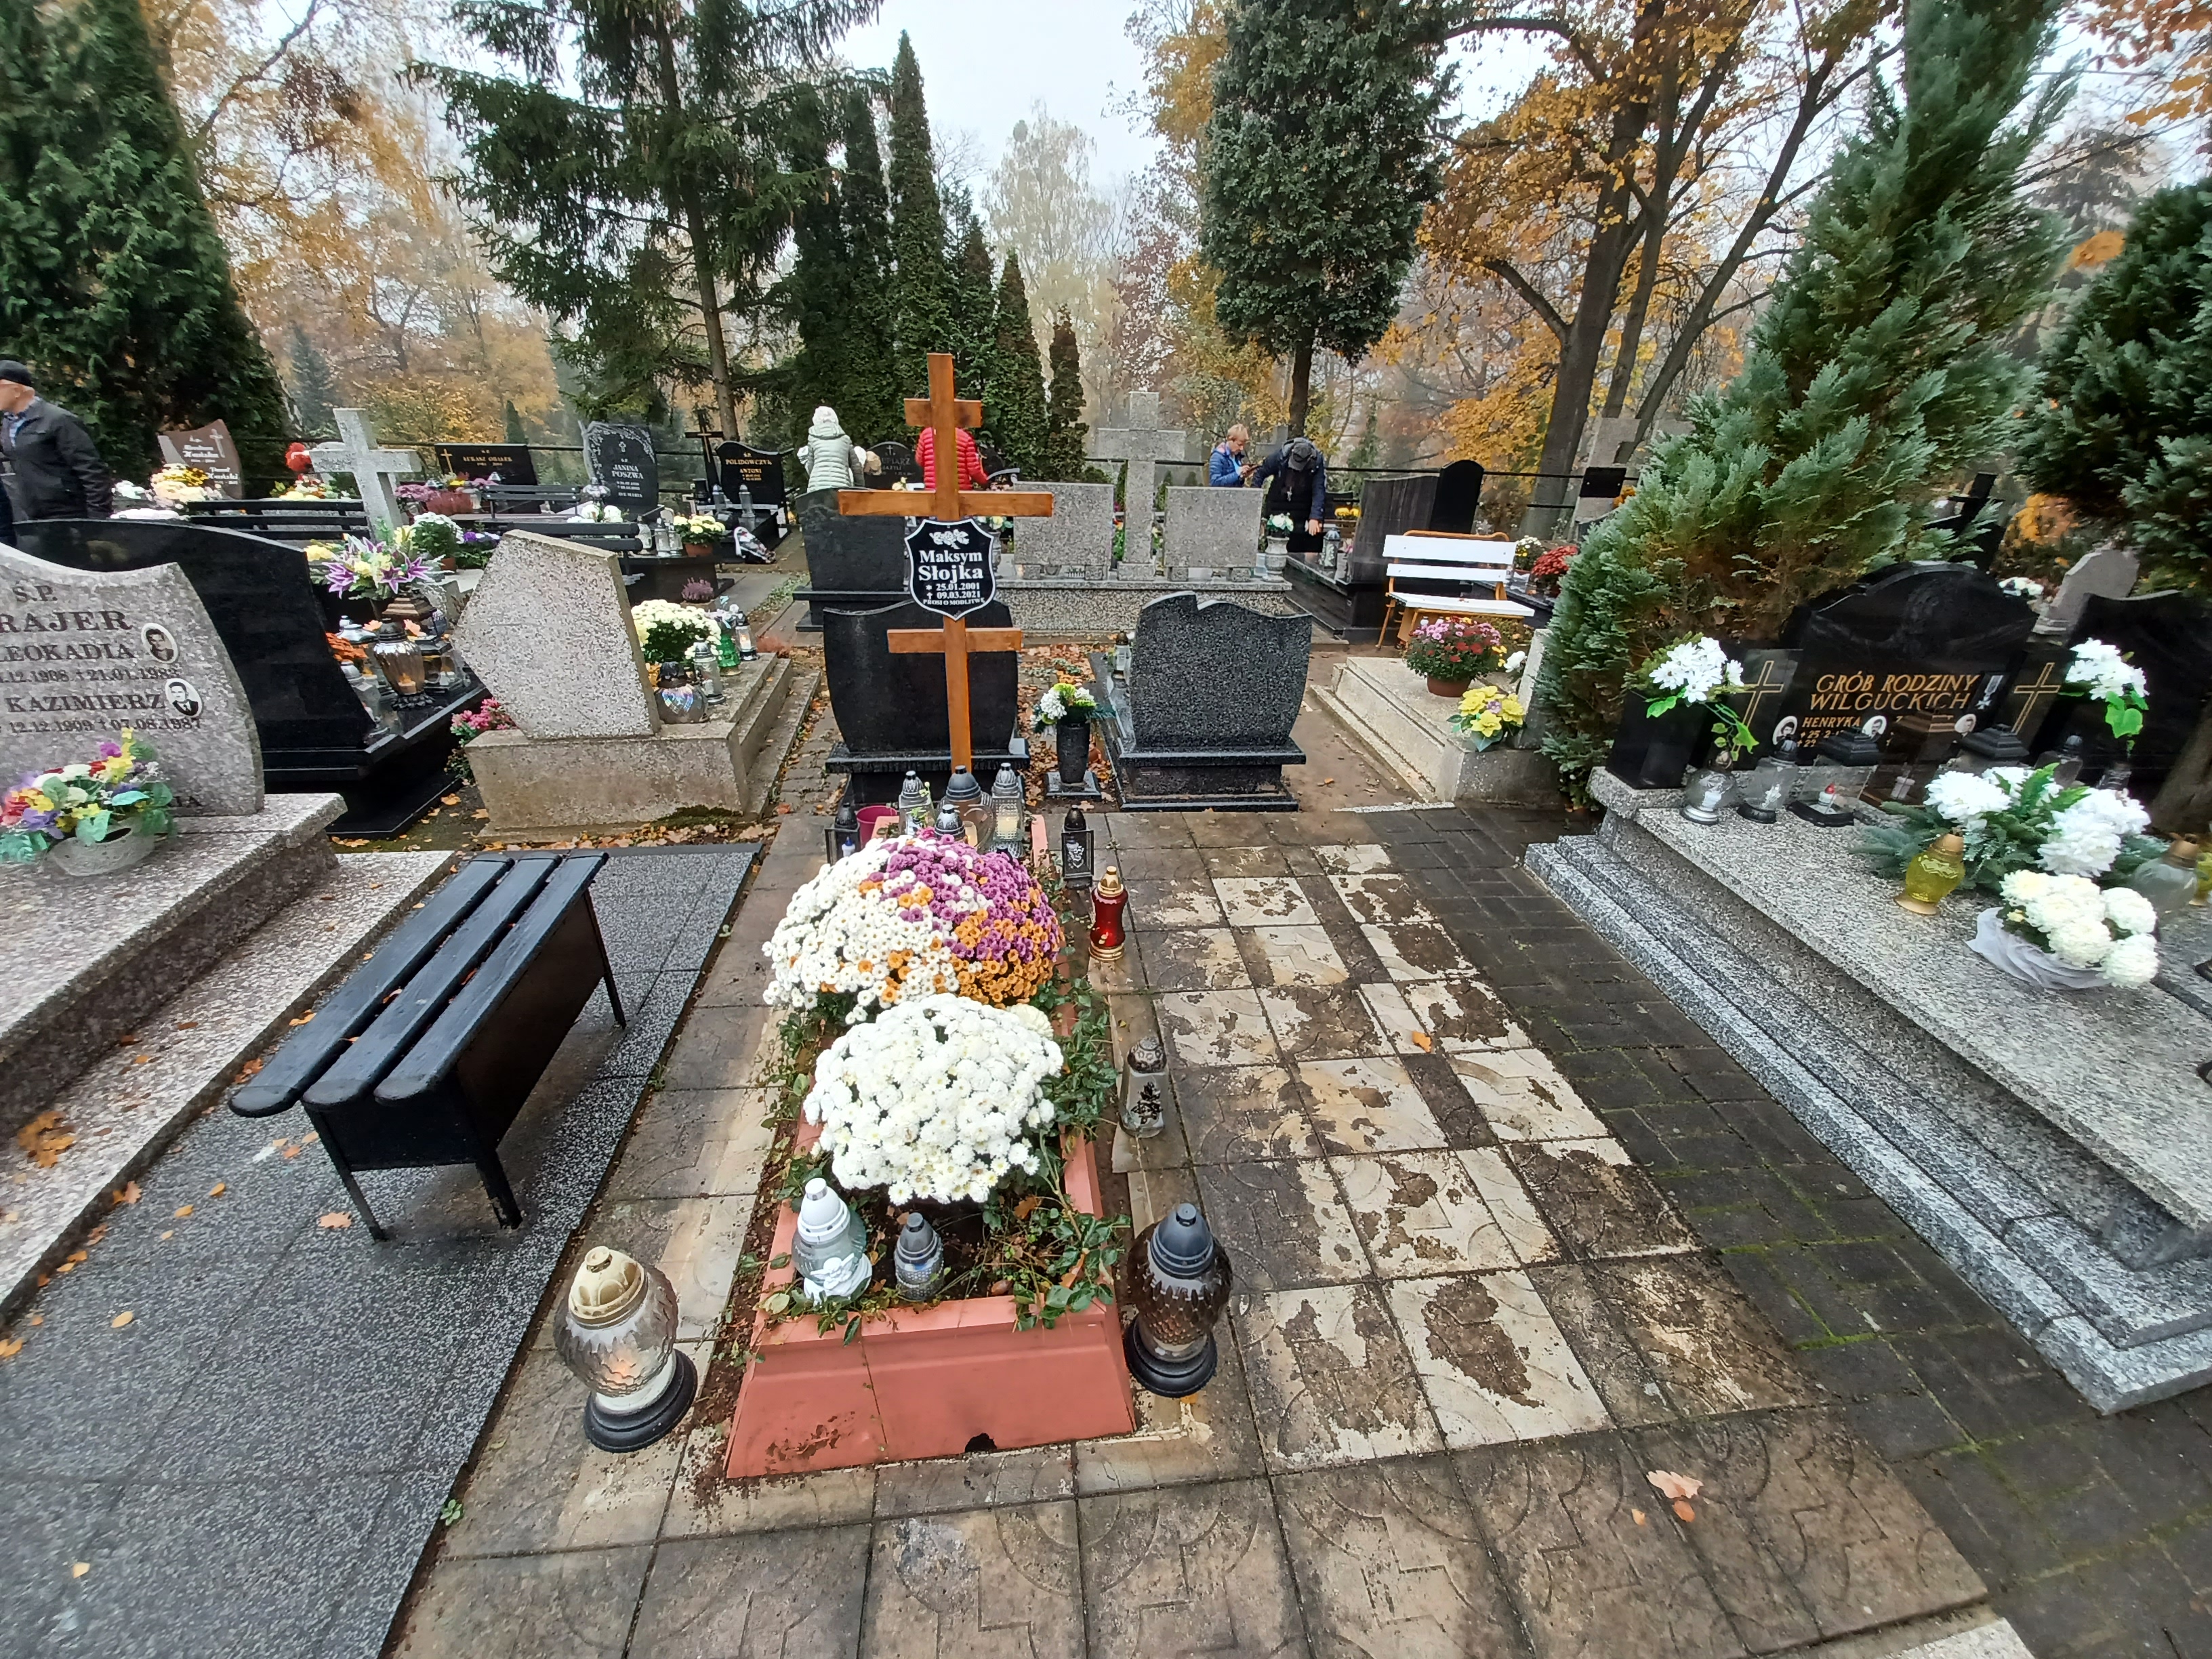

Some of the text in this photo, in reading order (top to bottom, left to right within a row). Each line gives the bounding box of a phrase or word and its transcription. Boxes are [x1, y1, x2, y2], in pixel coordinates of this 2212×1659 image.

[611, 471, 644, 479] POSZWA
[919, 550, 983, 565] Maksym
[918, 565, 984, 583] Słojka
[935, 582, 980, 591] 25.01.2001
[937, 590, 981, 599] 09.03.2021
[1816, 670, 1981, 693] GRÓB RODZINY
[5, 695, 166, 712] KAZIMIERZ
[1810, 692, 1971, 711] WILGUCKICH
[1802, 716, 1861, 727] HENRYKA
